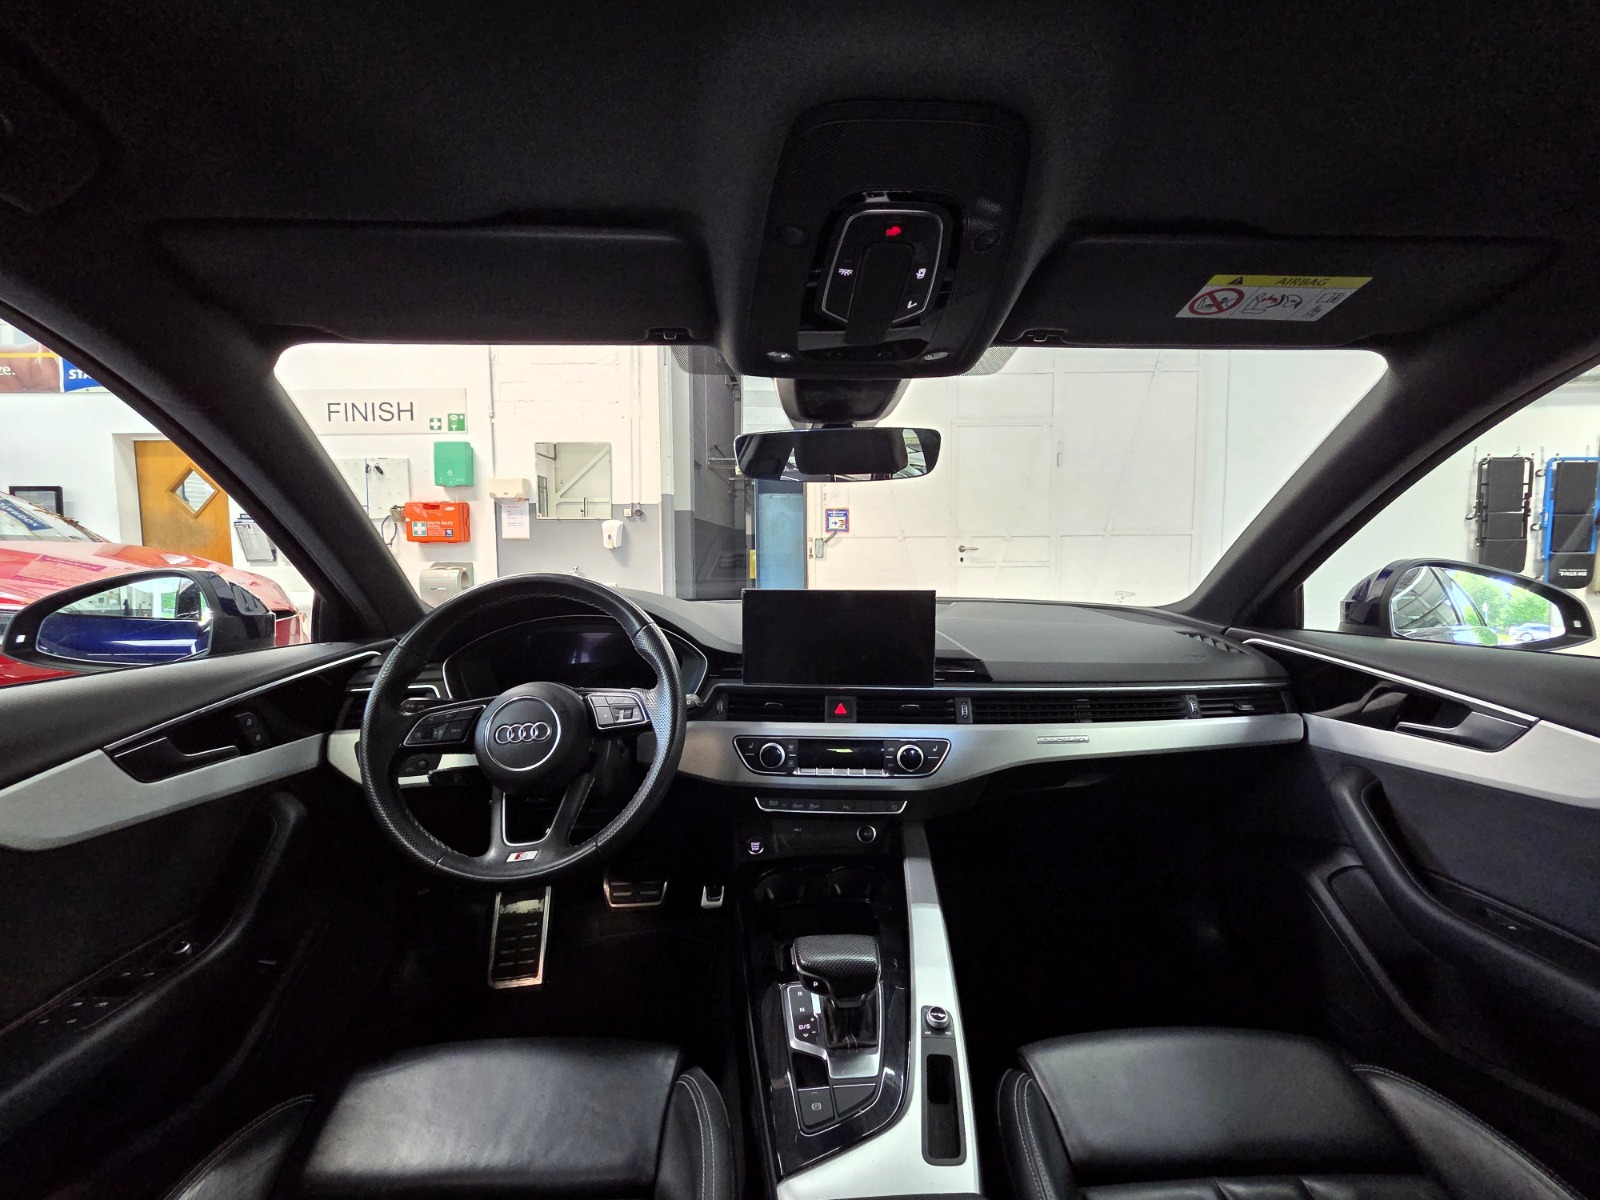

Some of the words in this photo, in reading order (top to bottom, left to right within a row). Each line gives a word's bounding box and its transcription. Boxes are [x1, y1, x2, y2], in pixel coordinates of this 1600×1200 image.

[1275, 277, 1330, 286] AIRBAG
[327, 401, 415, 423] FINISH
[798, 1023, 811, 1031] D/S
